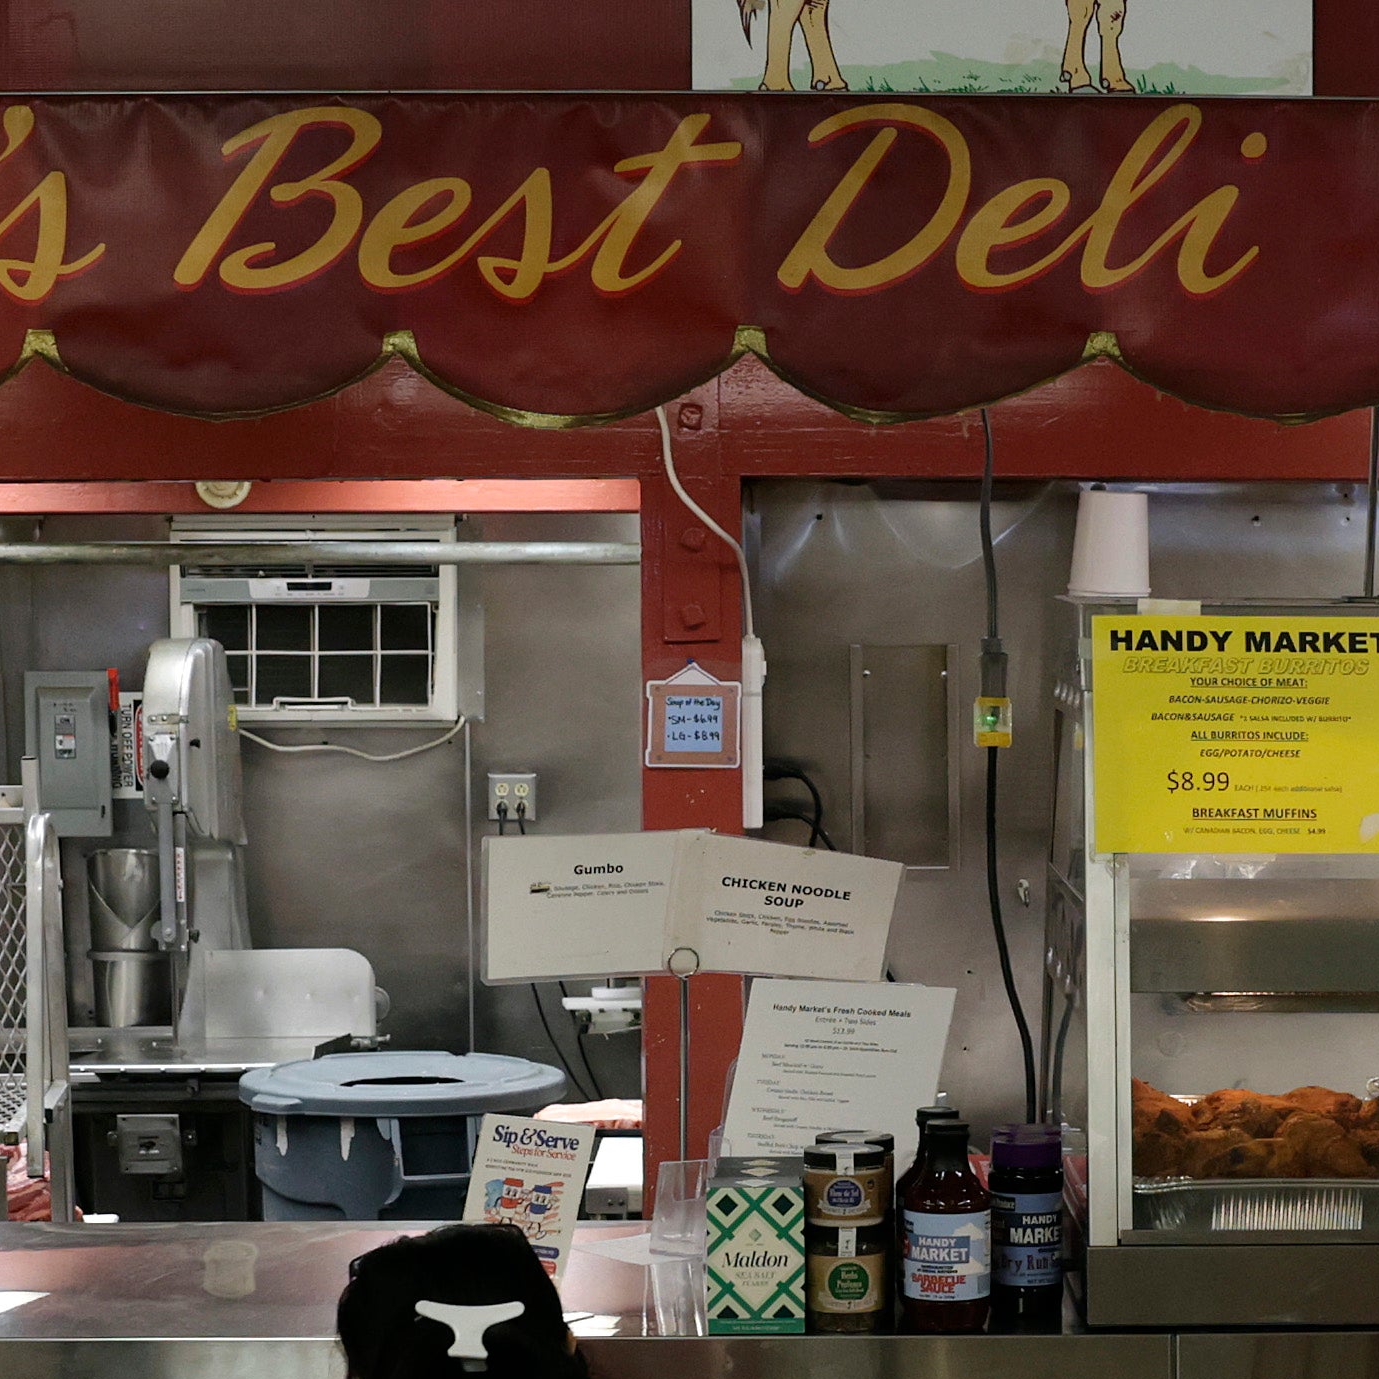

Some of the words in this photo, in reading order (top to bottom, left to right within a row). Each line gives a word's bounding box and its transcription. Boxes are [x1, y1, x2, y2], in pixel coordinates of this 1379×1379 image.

[174, 105, 742, 303] Best
[777, 103, 1267, 301] Deli
[1110, 630, 1233, 652] HANDY
[1122, 656, 1254, 674] BREAKFAST
[1258, 657, 1370, 676] BURRITOS
[1190, 677, 1219, 686] YOUR
[1221, 677, 1259, 687] CHOICE
[1261, 677, 1274, 687] OF
[1276, 677, 1308, 688] MEAT:
[666, 697, 684, 708] Soup
[693, 698, 704, 706] the
[705, 698, 721, 711] Day
[121, 703, 132, 729] TURN
[1151, 712, 1235, 721] BACON&SAUSAGE
[122, 731, 133, 750] OFF
[1191, 731, 1208, 740] ALL
[1211, 731, 1261, 740] BURRITOS
[1263, 731, 1309, 741] INCLUDE:
[1200, 749, 1301, 758] EGG/POTATO/CHEESE
[122, 753, 134, 787] POWER
[1167, 769, 1230, 794] $8.99
[1192, 808, 1260, 819] BREAKFAST
[1263, 808, 1317, 819] MUFFINS
[573, 863, 624, 875] Gumbo
[721, 876, 787, 893] CHICKEN
[791, 884, 852, 901] NOODLE
[764, 896, 804, 909] SOUP
[773, 1003, 797, 1013] Handy
[799, 1004, 831, 1013] Market's
[833, 1006, 853, 1014] Fresh
[857, 1008, 887, 1016] Cooked
[888, 1009, 911, 1018] Meals
[493, 1124, 518, 1147] Sip
[520, 1128, 536, 1145] &
[534, 1129, 580, 1151] Serve
[511, 1143, 533, 1158] Steps
[533, 1147, 547, 1157] for
[546, 1149, 577, 1162] Service
[1022, 1214, 1057, 1225] HANDY
[918, 1236, 957, 1247] HANDY
[722, 1251, 789, 1269] Maldon
[911, 1247, 969, 1262] MARKET
[911, 1273, 967, 1285] BARBECUE
[920, 1282, 956, 1294] SAUCE
